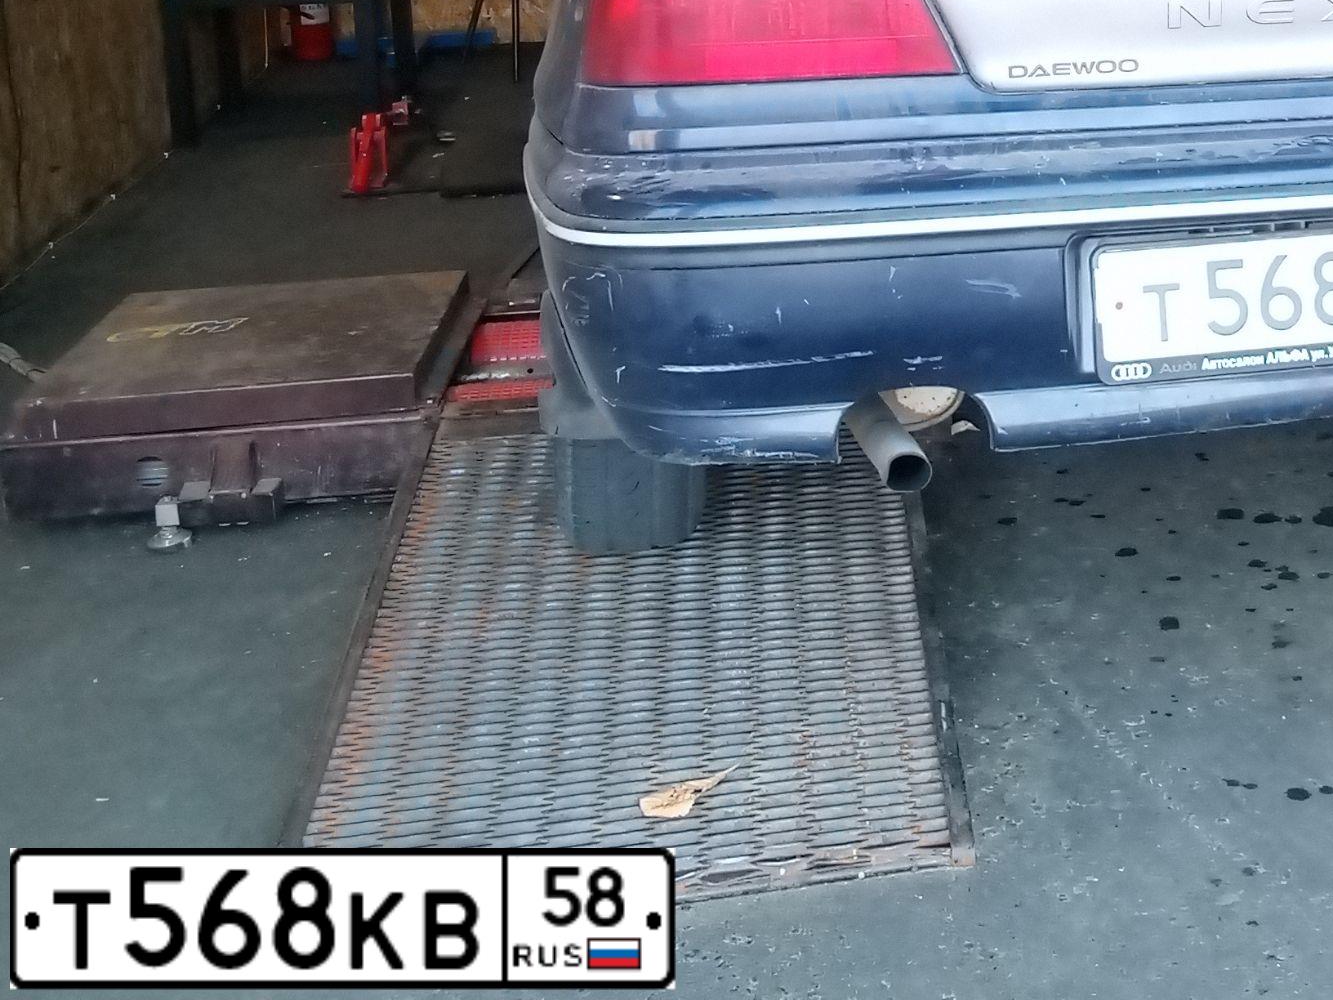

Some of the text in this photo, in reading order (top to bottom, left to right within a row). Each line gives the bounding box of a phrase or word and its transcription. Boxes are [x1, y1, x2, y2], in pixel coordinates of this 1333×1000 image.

[1007, 58, 1140, 79] DAEWOO
[1159, 360, 1197, 374] Audi
[1201, 355, 1264, 371] Автосалон
